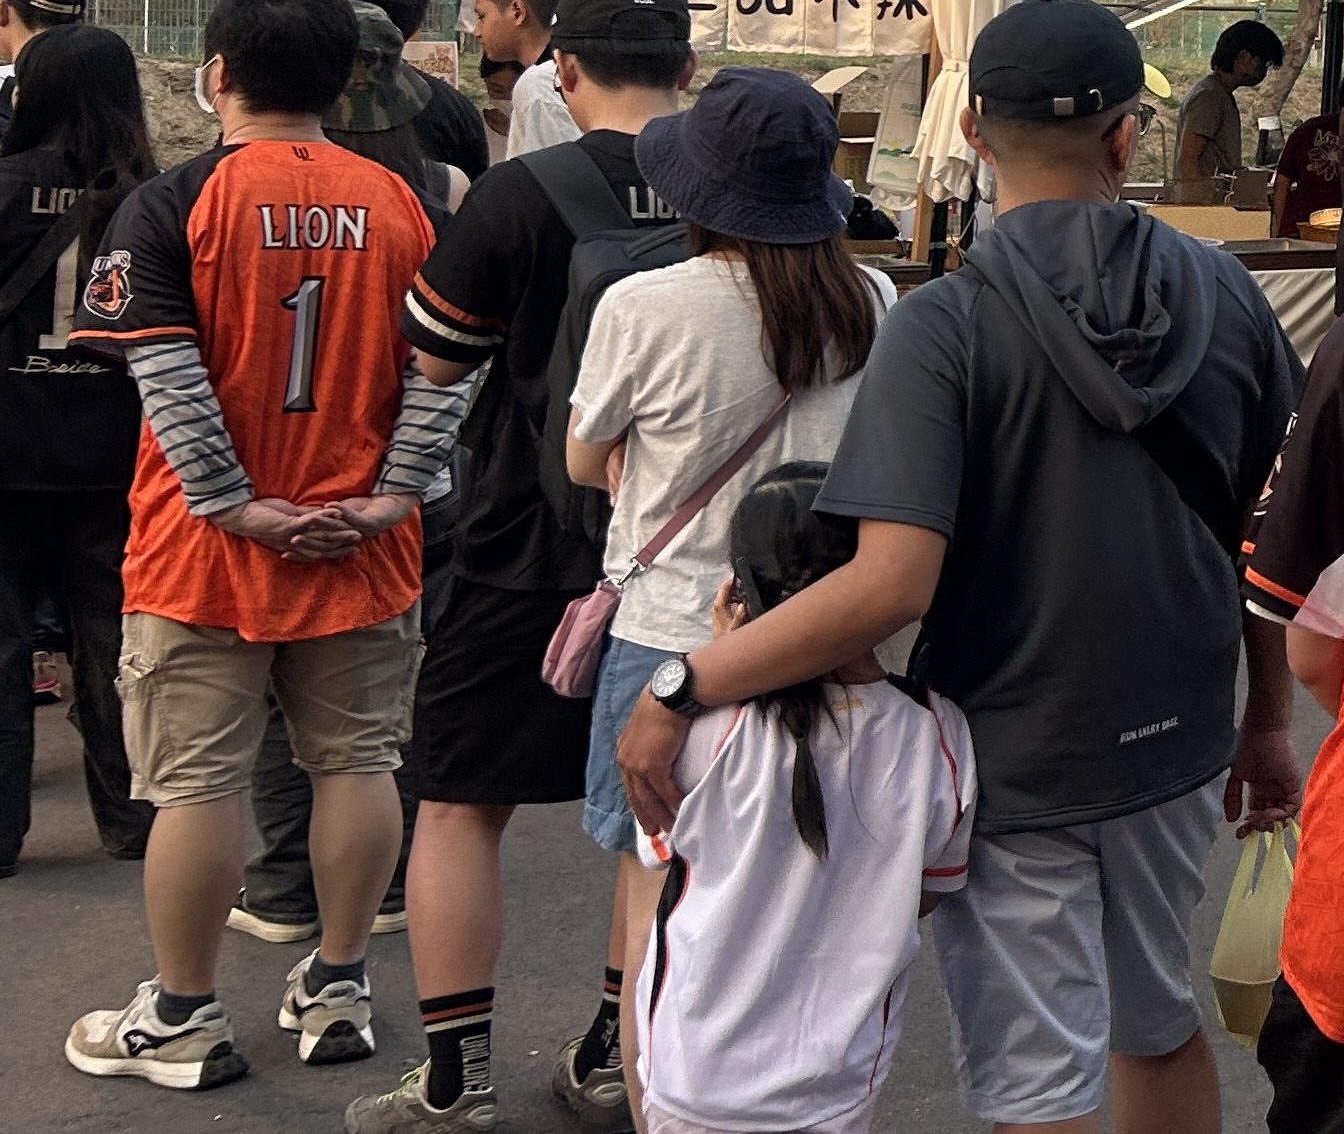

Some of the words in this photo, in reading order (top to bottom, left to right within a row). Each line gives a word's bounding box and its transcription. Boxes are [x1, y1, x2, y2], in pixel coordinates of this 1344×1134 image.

[31, 186, 85, 214] LIO
[628, 186, 682, 219] LIO
[256, 203, 372, 252] LION
[279, 275, 326, 414] 1
